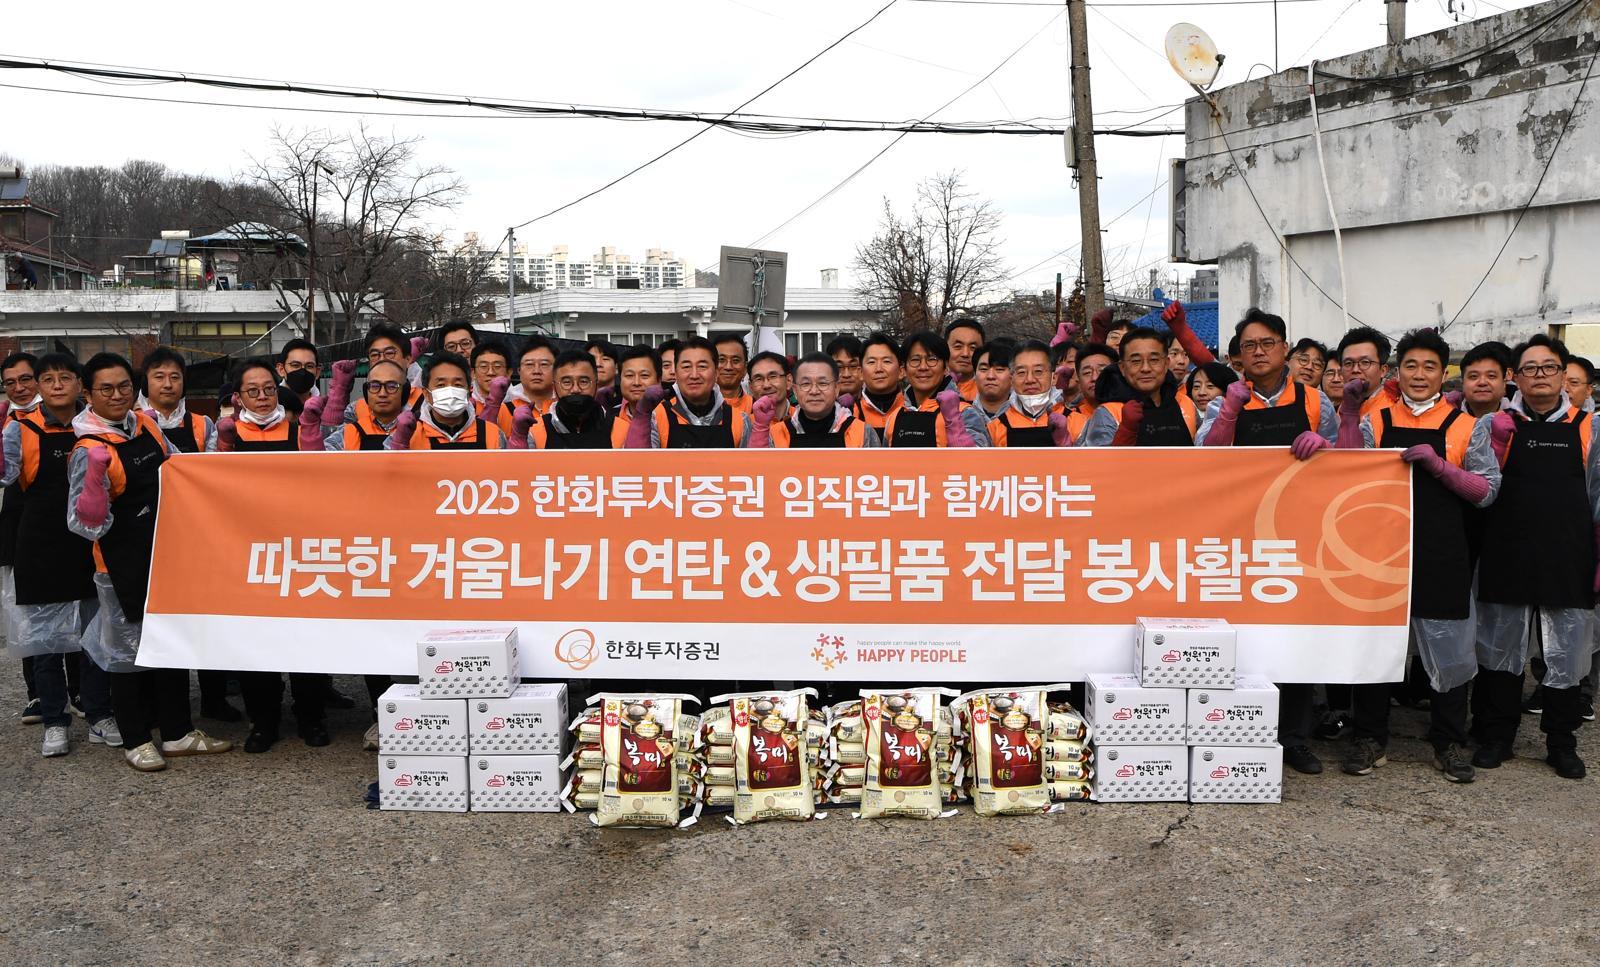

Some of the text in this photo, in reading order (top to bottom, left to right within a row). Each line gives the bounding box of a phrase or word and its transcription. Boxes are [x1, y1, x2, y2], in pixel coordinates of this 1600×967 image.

[436, 475, 1095, 518] 2025 한화투자증권 임직원과 함께하는
[247, 537, 1303, 603] 따뜻한 겨울나기 연탄 & 생필품 전달 봉사활동
[606, 641, 719, 660] 한화투자증권
[857, 649, 967, 663] HAPPY PEOPLE
[1183, 651, 1219, 662] 청원김치
[454, 661, 490, 672] 청원김치
[1133, 708, 1169, 719] 청원김치
[1226, 709, 1262, 720] 청원김치
[413, 719, 449, 729] 청원김치
[505, 717, 541, 728] 청원김치
[1135, 765, 1171, 776] 청원김치
[1230, 767, 1266, 777] 청원김치
[412, 775, 448, 786] 청원김치
[505, 775, 541, 786] 청원김치
